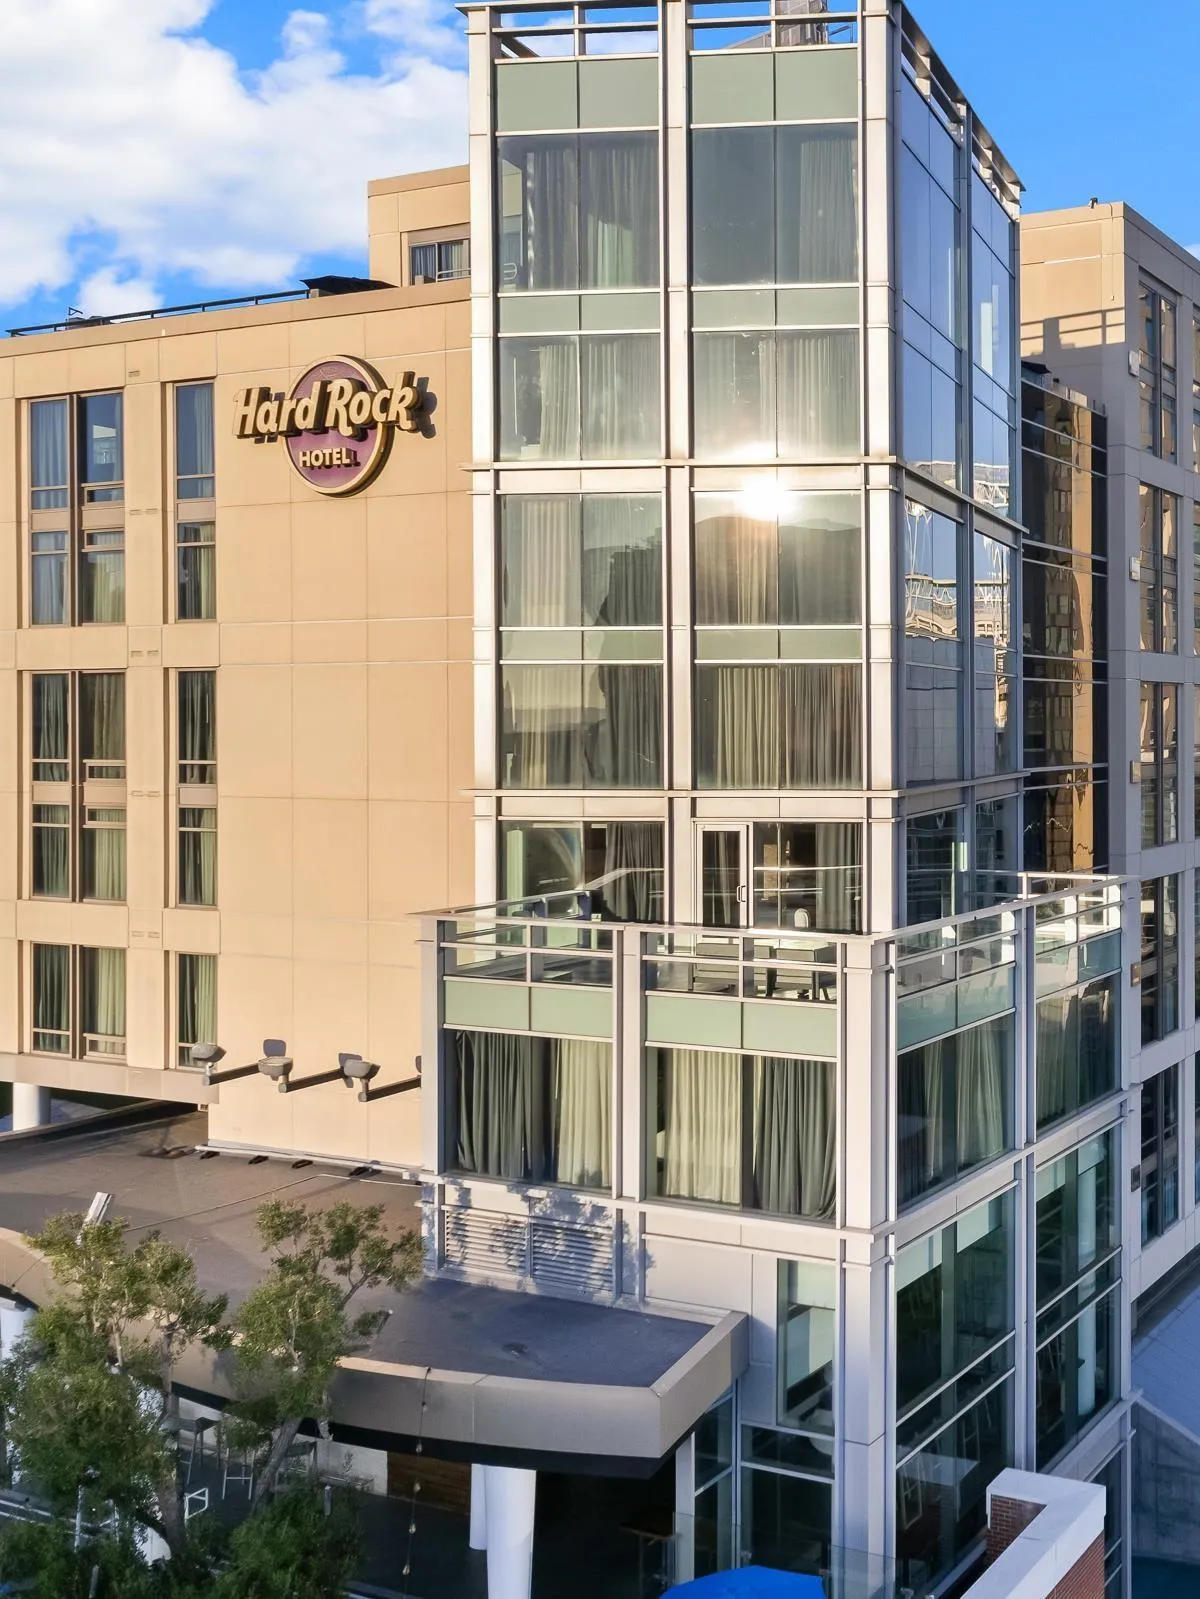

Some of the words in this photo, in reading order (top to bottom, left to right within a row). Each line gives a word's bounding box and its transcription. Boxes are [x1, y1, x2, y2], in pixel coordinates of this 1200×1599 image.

[232, 381, 327, 437] Hard
[326, 371, 419, 437] Rock
[300, 448, 352, 468] HOTEL
